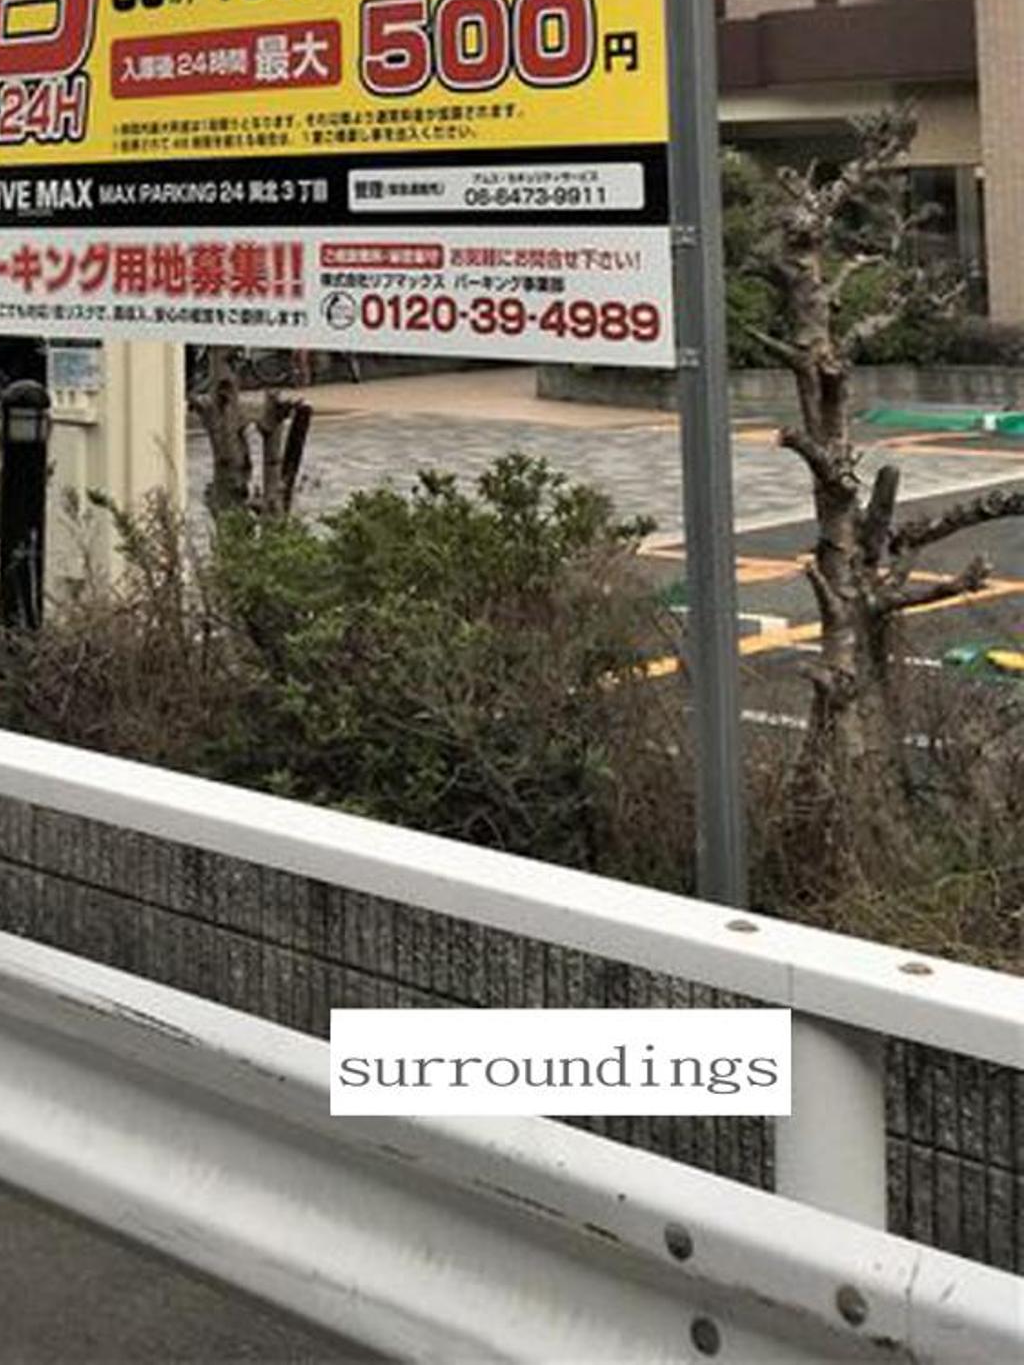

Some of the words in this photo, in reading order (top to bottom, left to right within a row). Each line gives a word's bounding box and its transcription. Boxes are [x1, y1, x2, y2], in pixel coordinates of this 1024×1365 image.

[254, 30, 328, 82] 最大
[36, 179, 93, 209] MAX
[99, 185, 135, 205] MAX
[139, 182, 216, 205] PARKING
[220, 181, 244, 203] 24
[361, 294, 660, 342] 0120-39-4989
